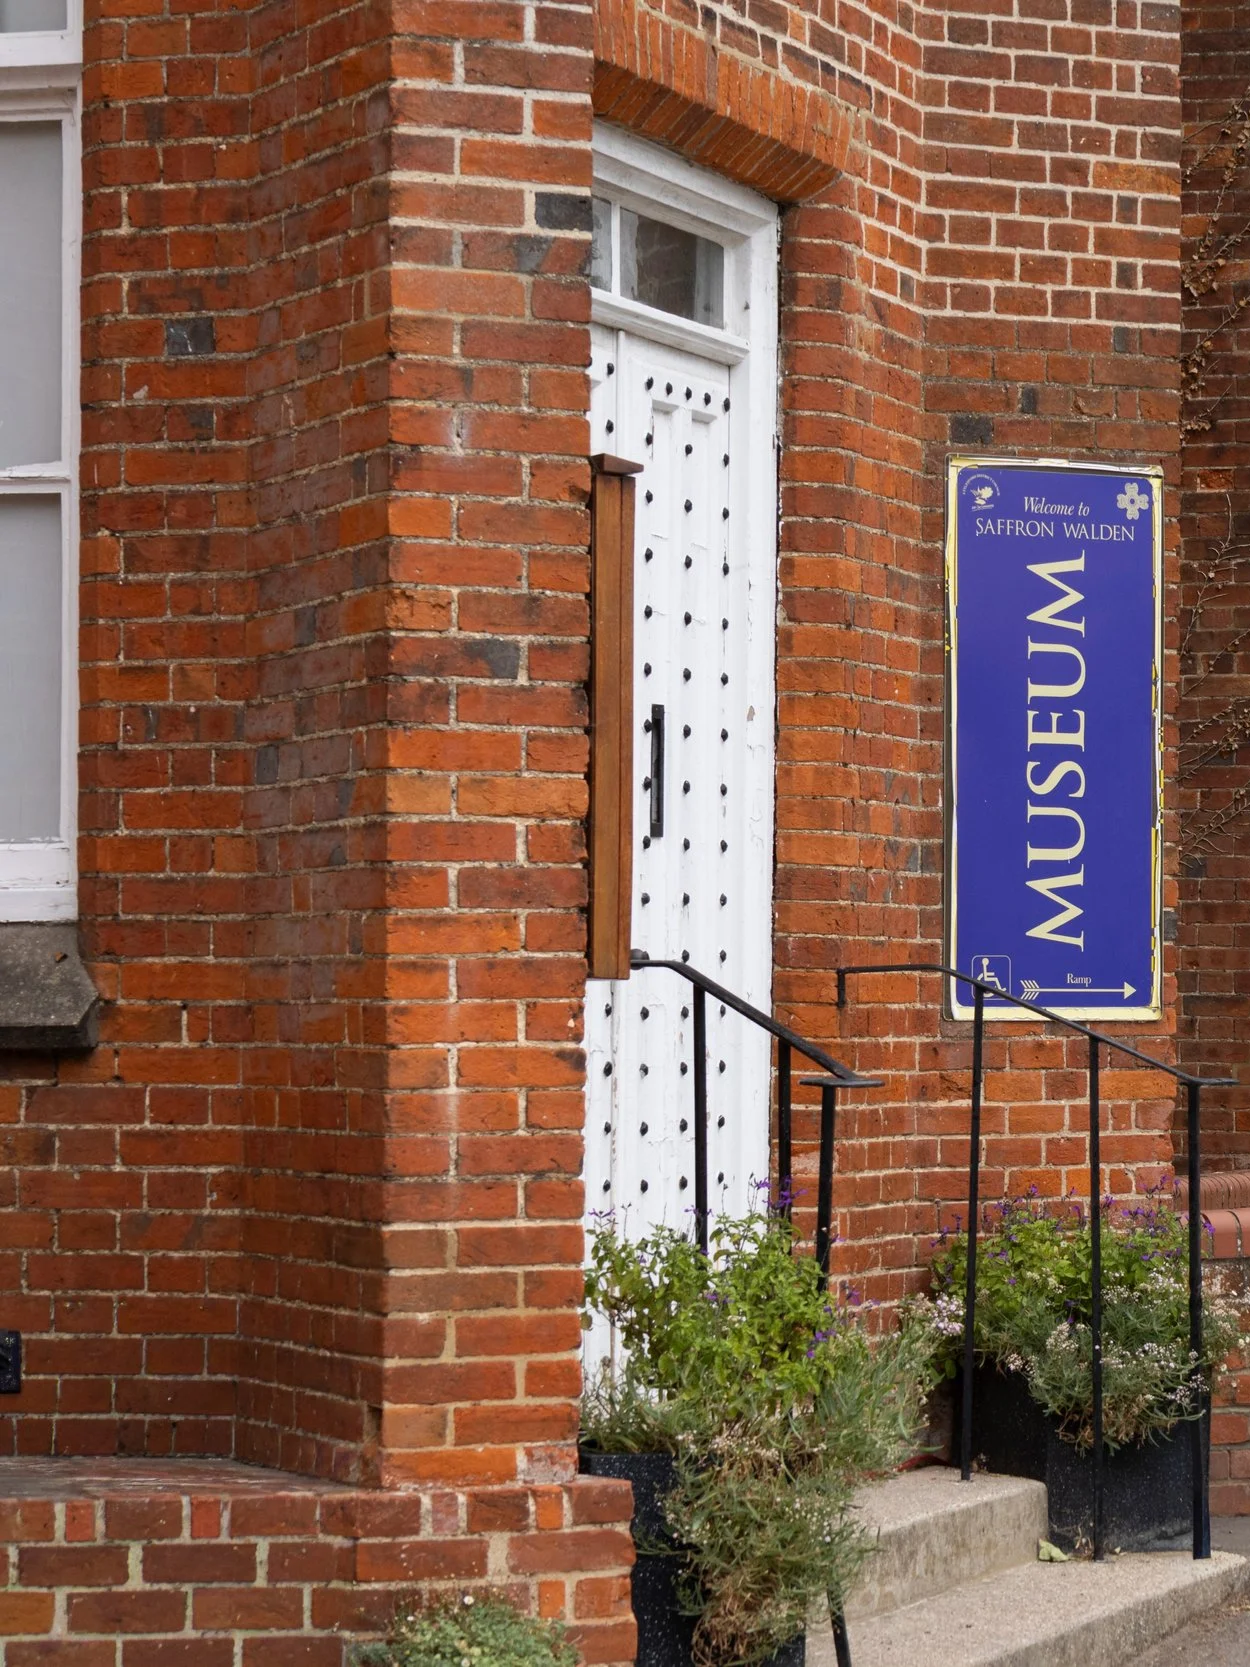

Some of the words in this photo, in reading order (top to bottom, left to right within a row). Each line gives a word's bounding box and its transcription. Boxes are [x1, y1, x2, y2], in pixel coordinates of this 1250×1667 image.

[1024, 496, 1074, 516] Welcome
[1078, 501, 1090, 517] to
[976, 517, 1054, 537] SAFFRON
[1063, 522, 1135, 541] WALDEN
[1026, 549, 1086, 952] MUSEUM
[1067, 973, 1092, 987] Ramp
